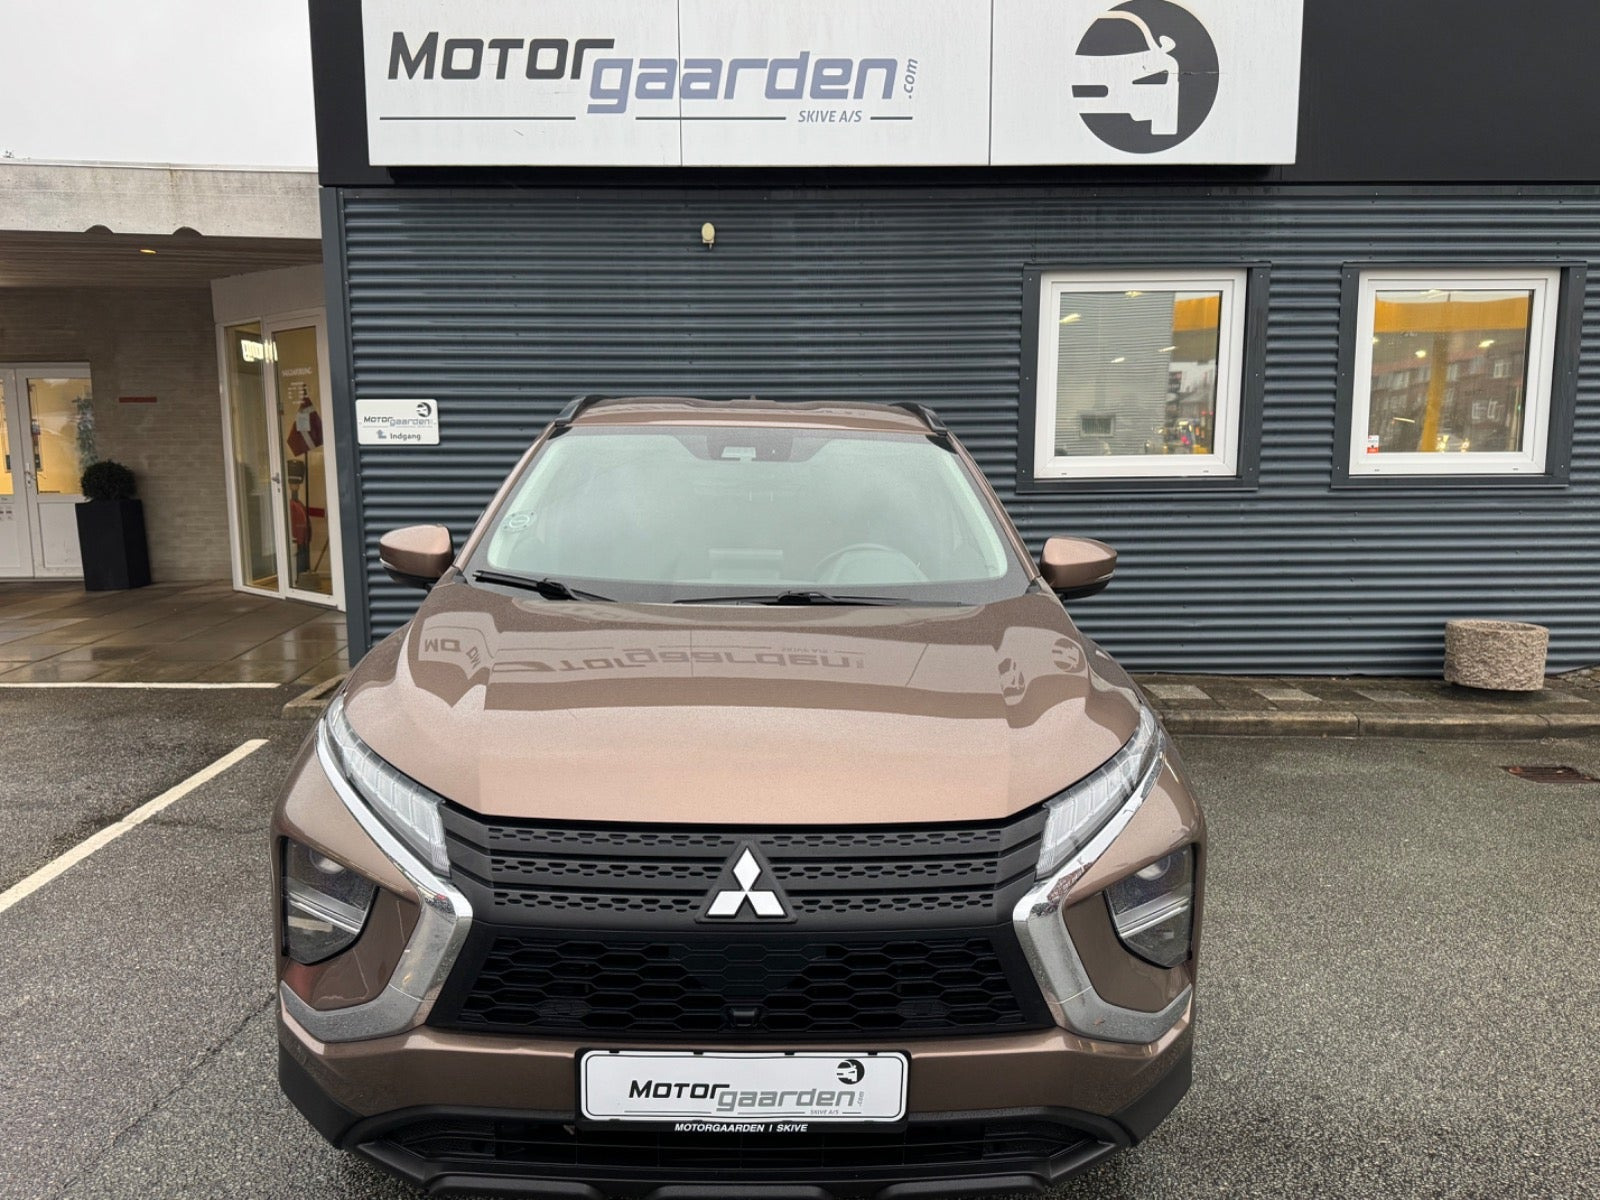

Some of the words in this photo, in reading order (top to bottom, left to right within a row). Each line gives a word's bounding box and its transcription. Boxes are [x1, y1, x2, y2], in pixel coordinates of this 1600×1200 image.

[798, 110, 837, 123] SKIVE
[838, 110, 862, 123] A/S
[390, 433, 421, 441] Indgang
[674, 1123, 764, 1132] MOTORGAARDEN
[776, 1124, 808, 1132] SKIVE
